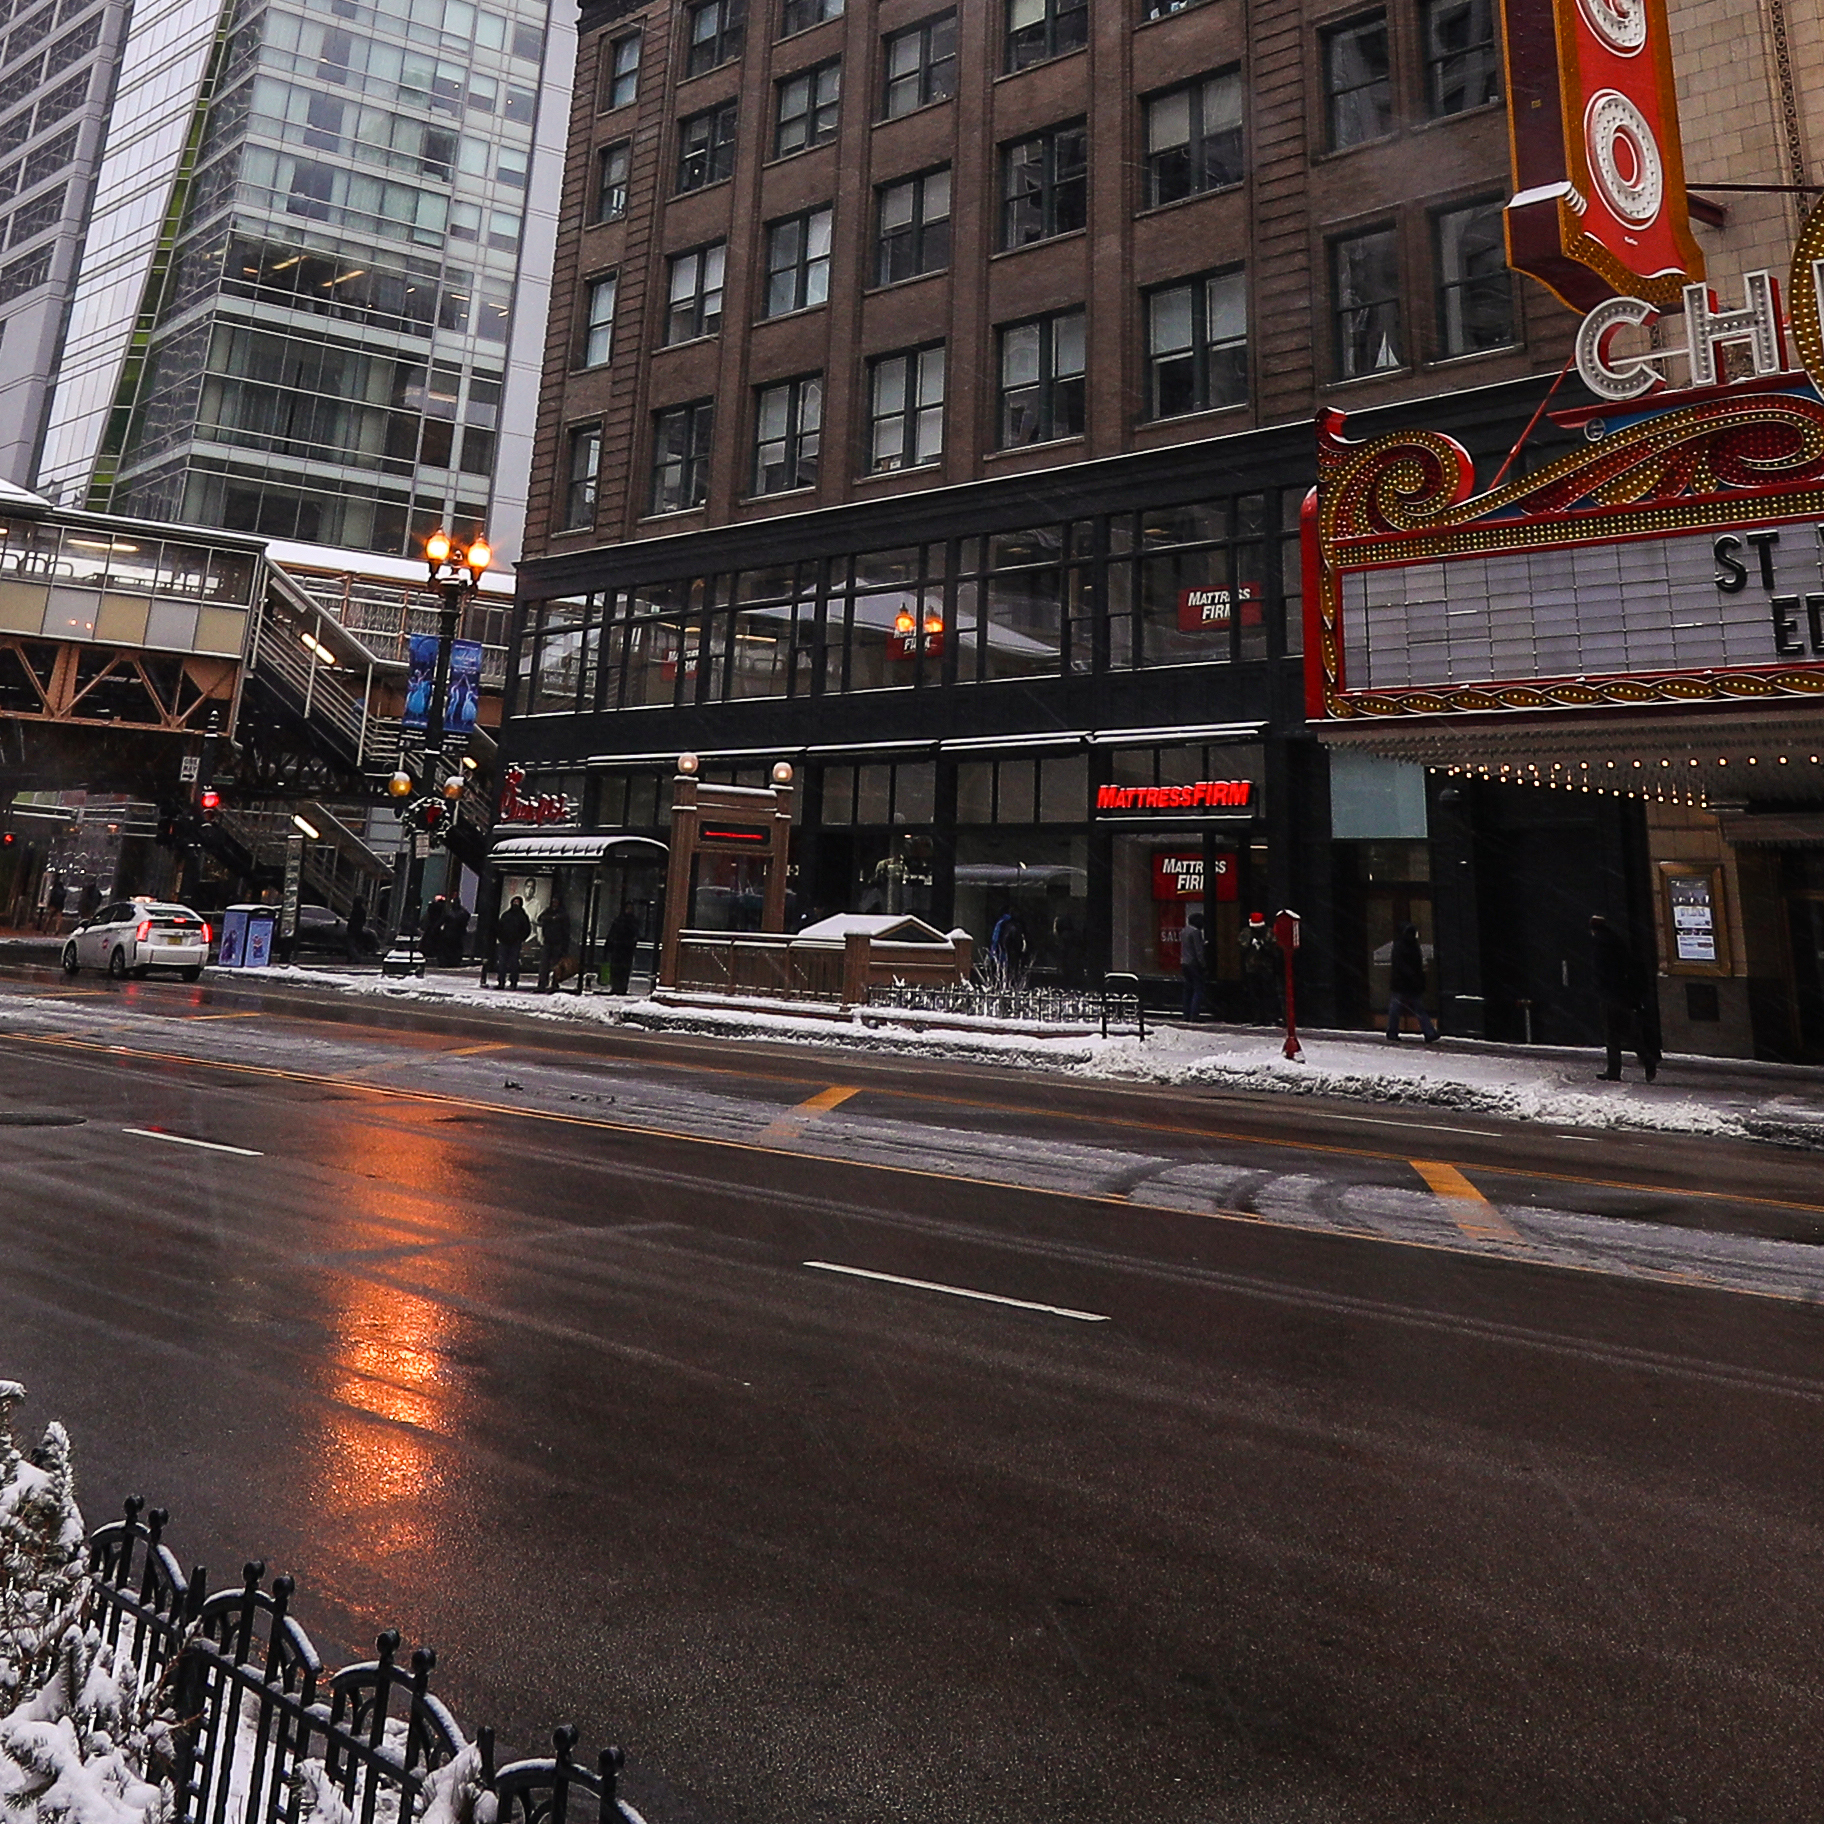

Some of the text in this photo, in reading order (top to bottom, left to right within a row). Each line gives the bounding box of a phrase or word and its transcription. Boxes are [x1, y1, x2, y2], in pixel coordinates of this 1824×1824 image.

[1713, 528, 1780, 593] ST
[1188, 588, 1251, 606] MATTRSS
[1162, 858, 1227, 874] MATTRSS
[1177, 875, 1204, 890] FIR
